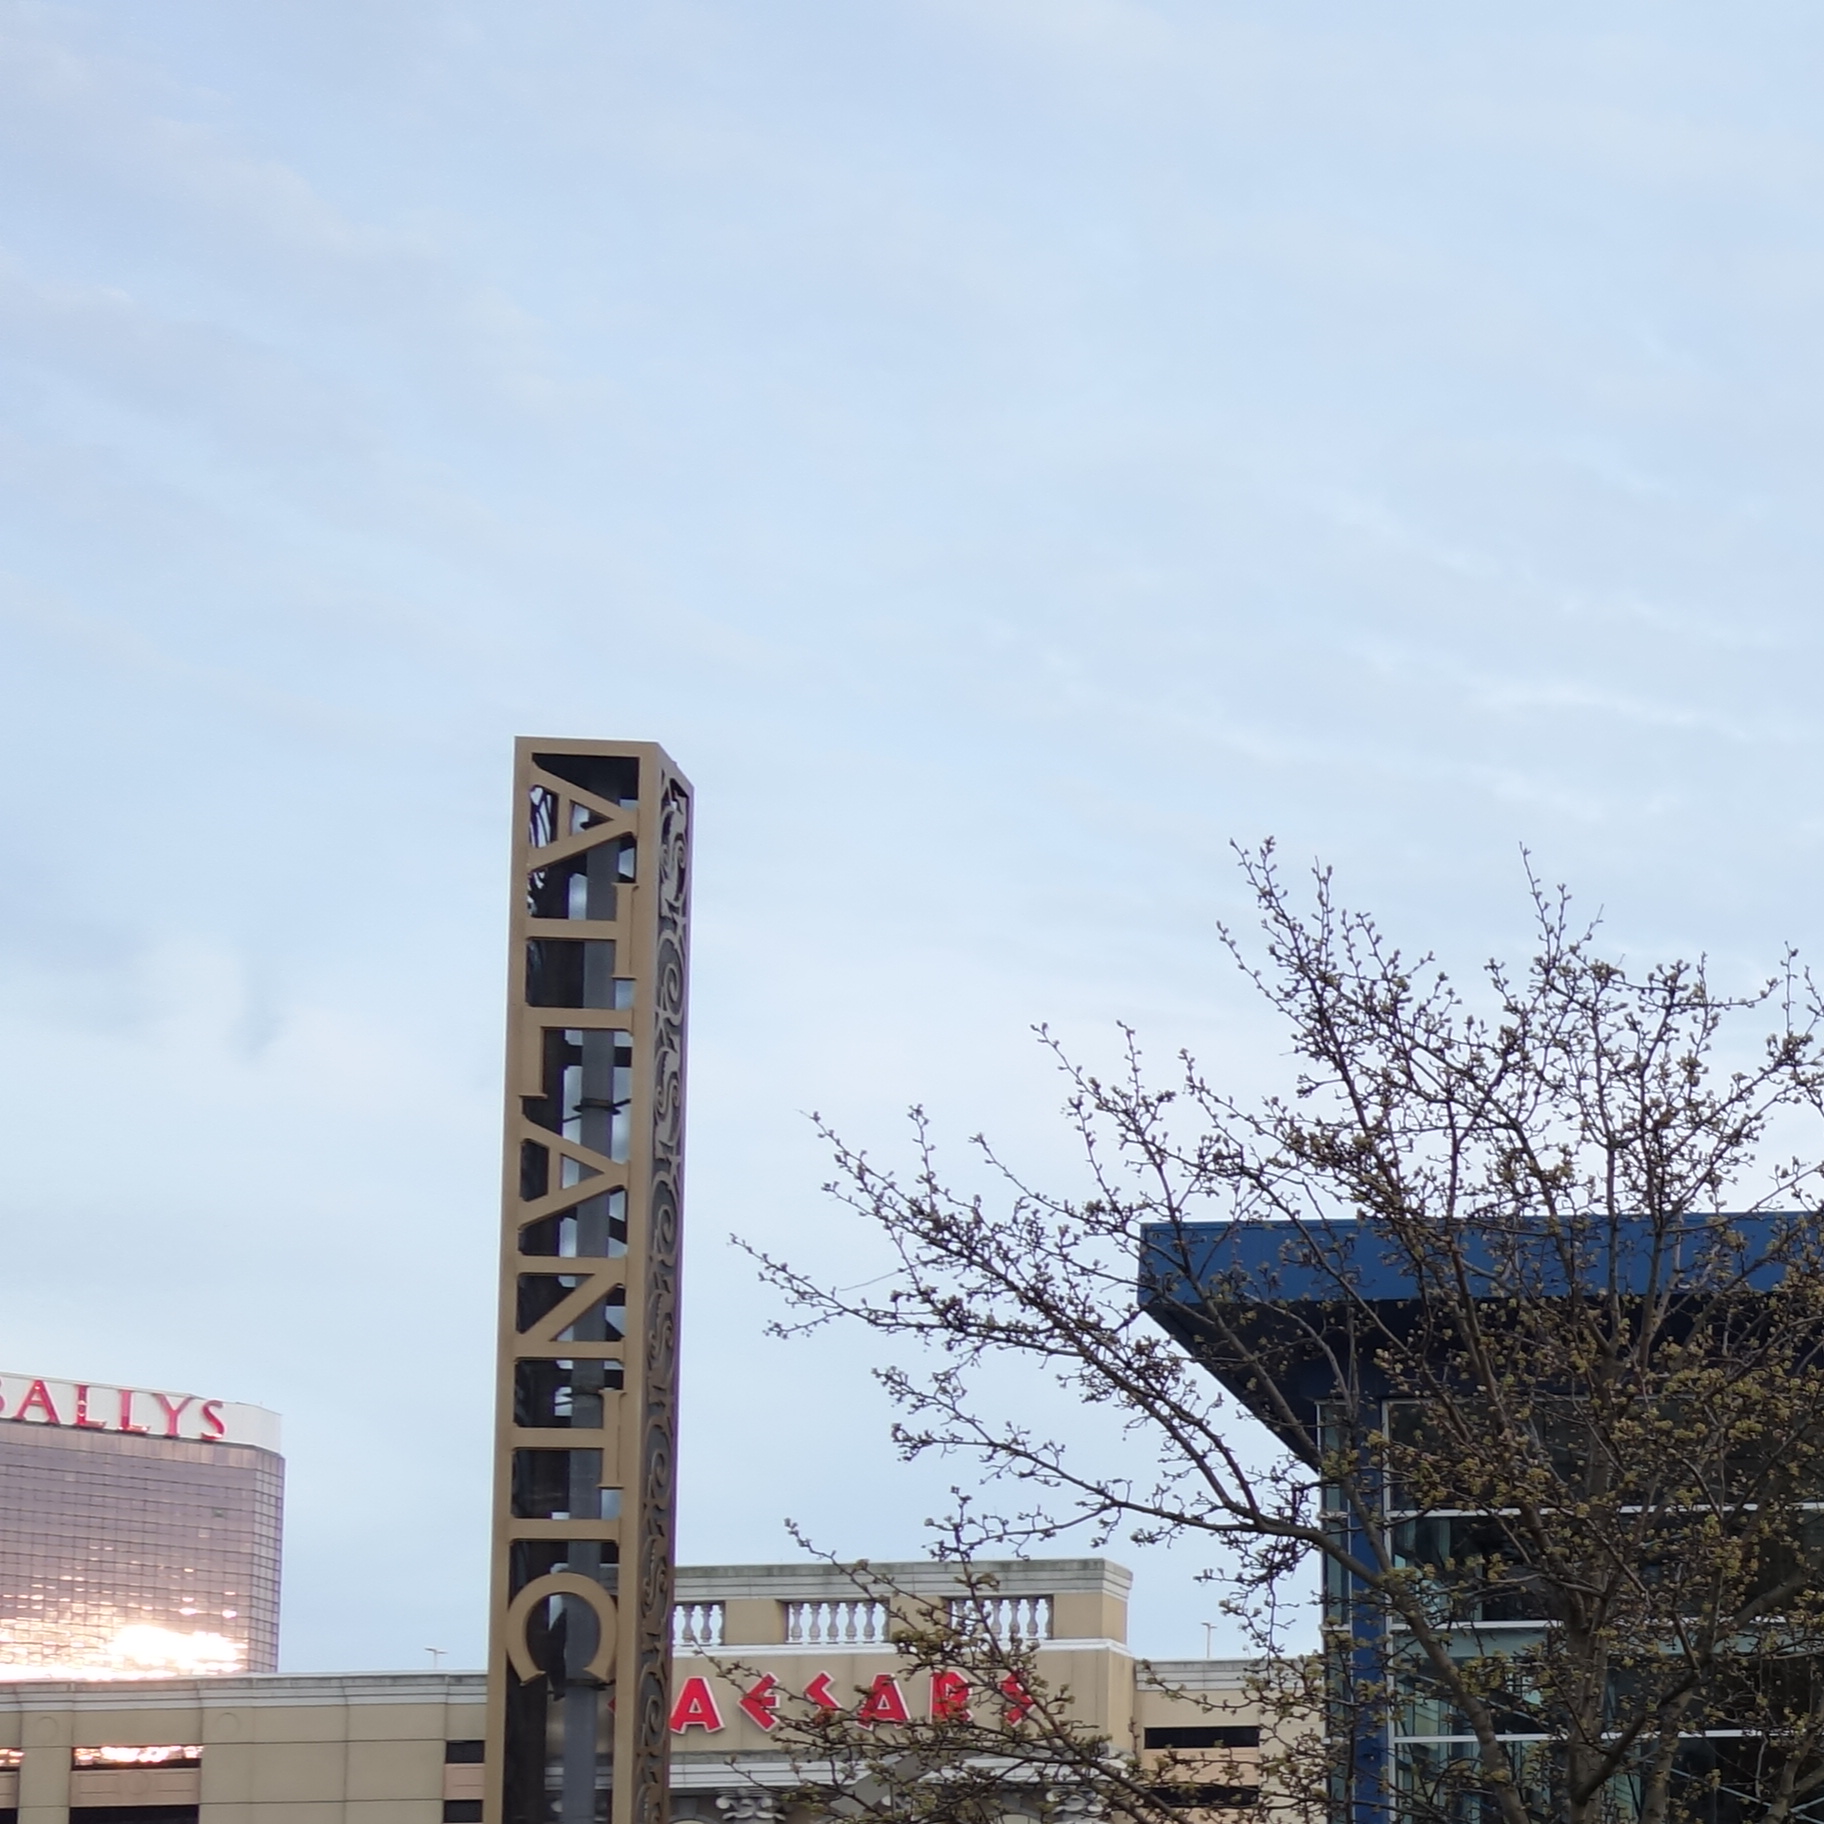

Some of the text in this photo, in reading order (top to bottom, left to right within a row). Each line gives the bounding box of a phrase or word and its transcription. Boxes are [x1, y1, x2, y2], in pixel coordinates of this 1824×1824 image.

[505, 759, 639, 1689] ATLANTIC
[0, 1376, 225, 1441] ALLYS
[668, 1669, 1037, 1736] AESARS
